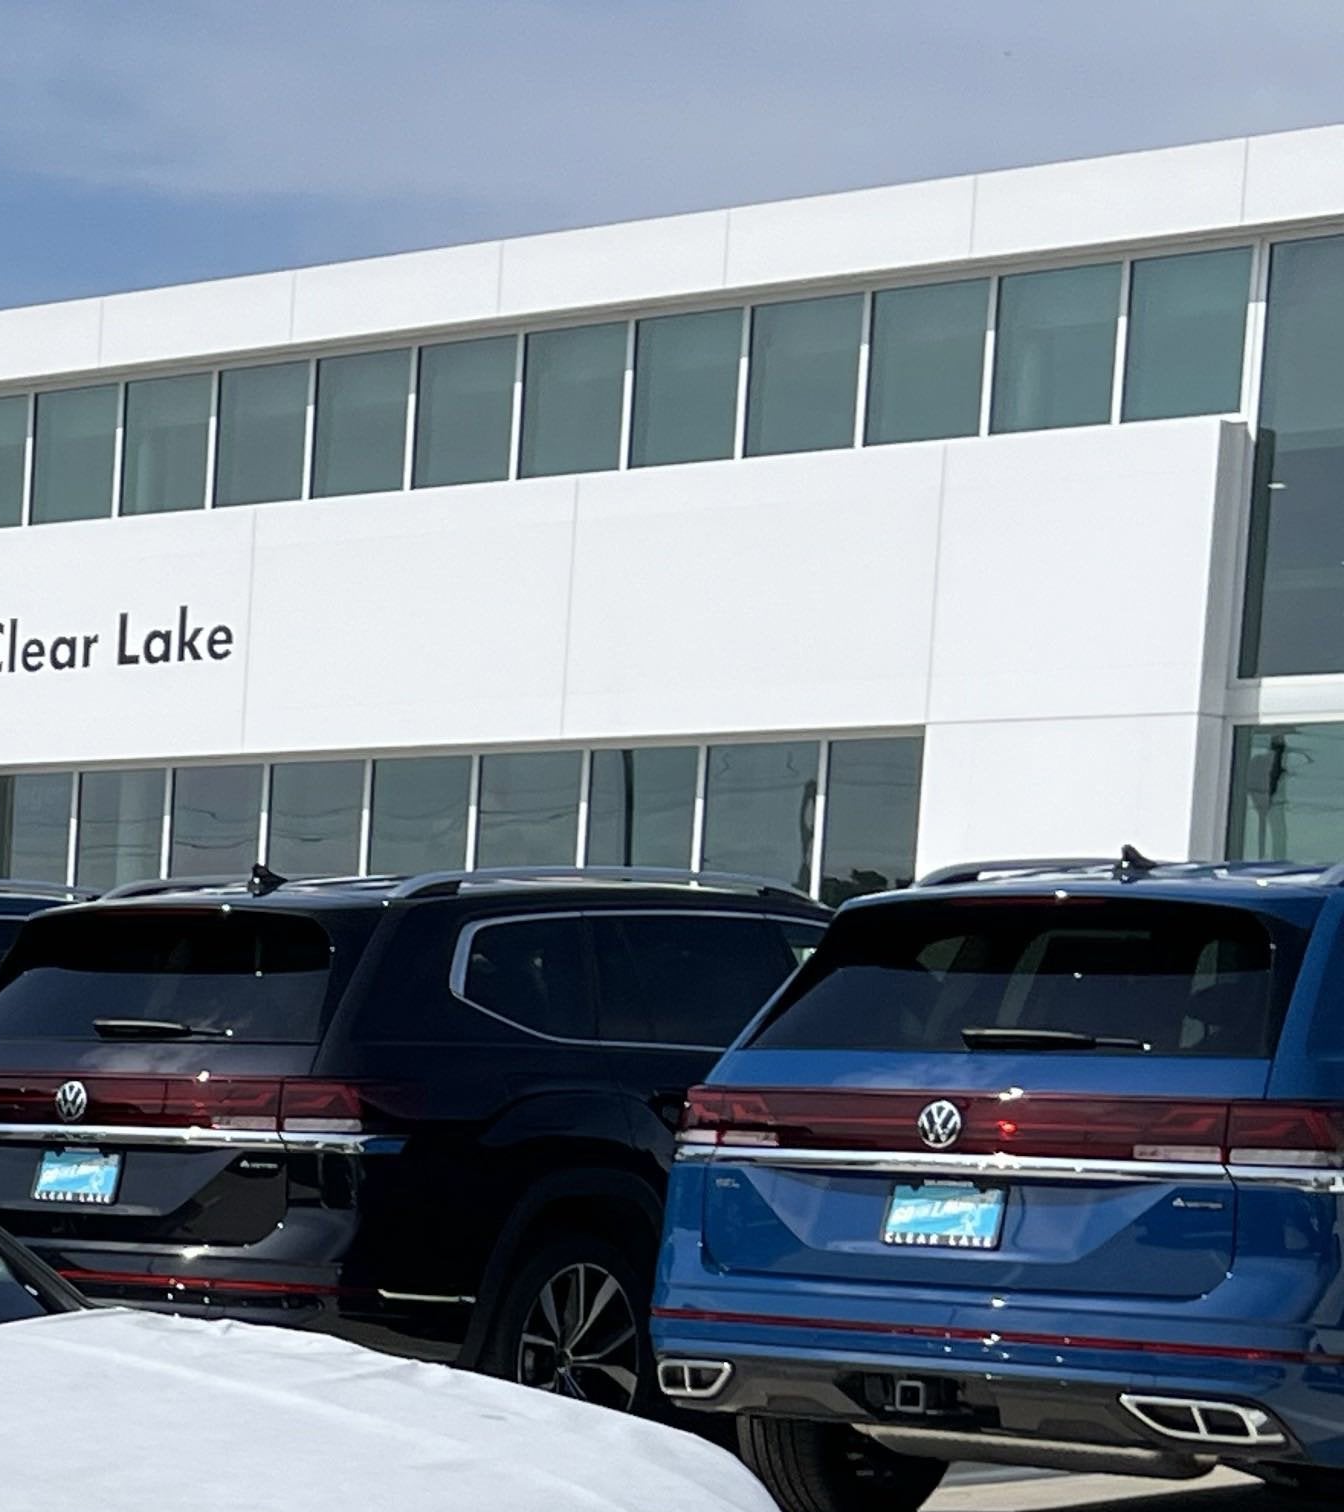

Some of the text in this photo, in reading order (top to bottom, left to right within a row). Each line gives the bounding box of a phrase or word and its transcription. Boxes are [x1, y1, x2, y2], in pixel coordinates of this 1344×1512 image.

[117, 605, 234, 666] Lake
[884, 1231, 992, 1248] CLEAR LAKE
